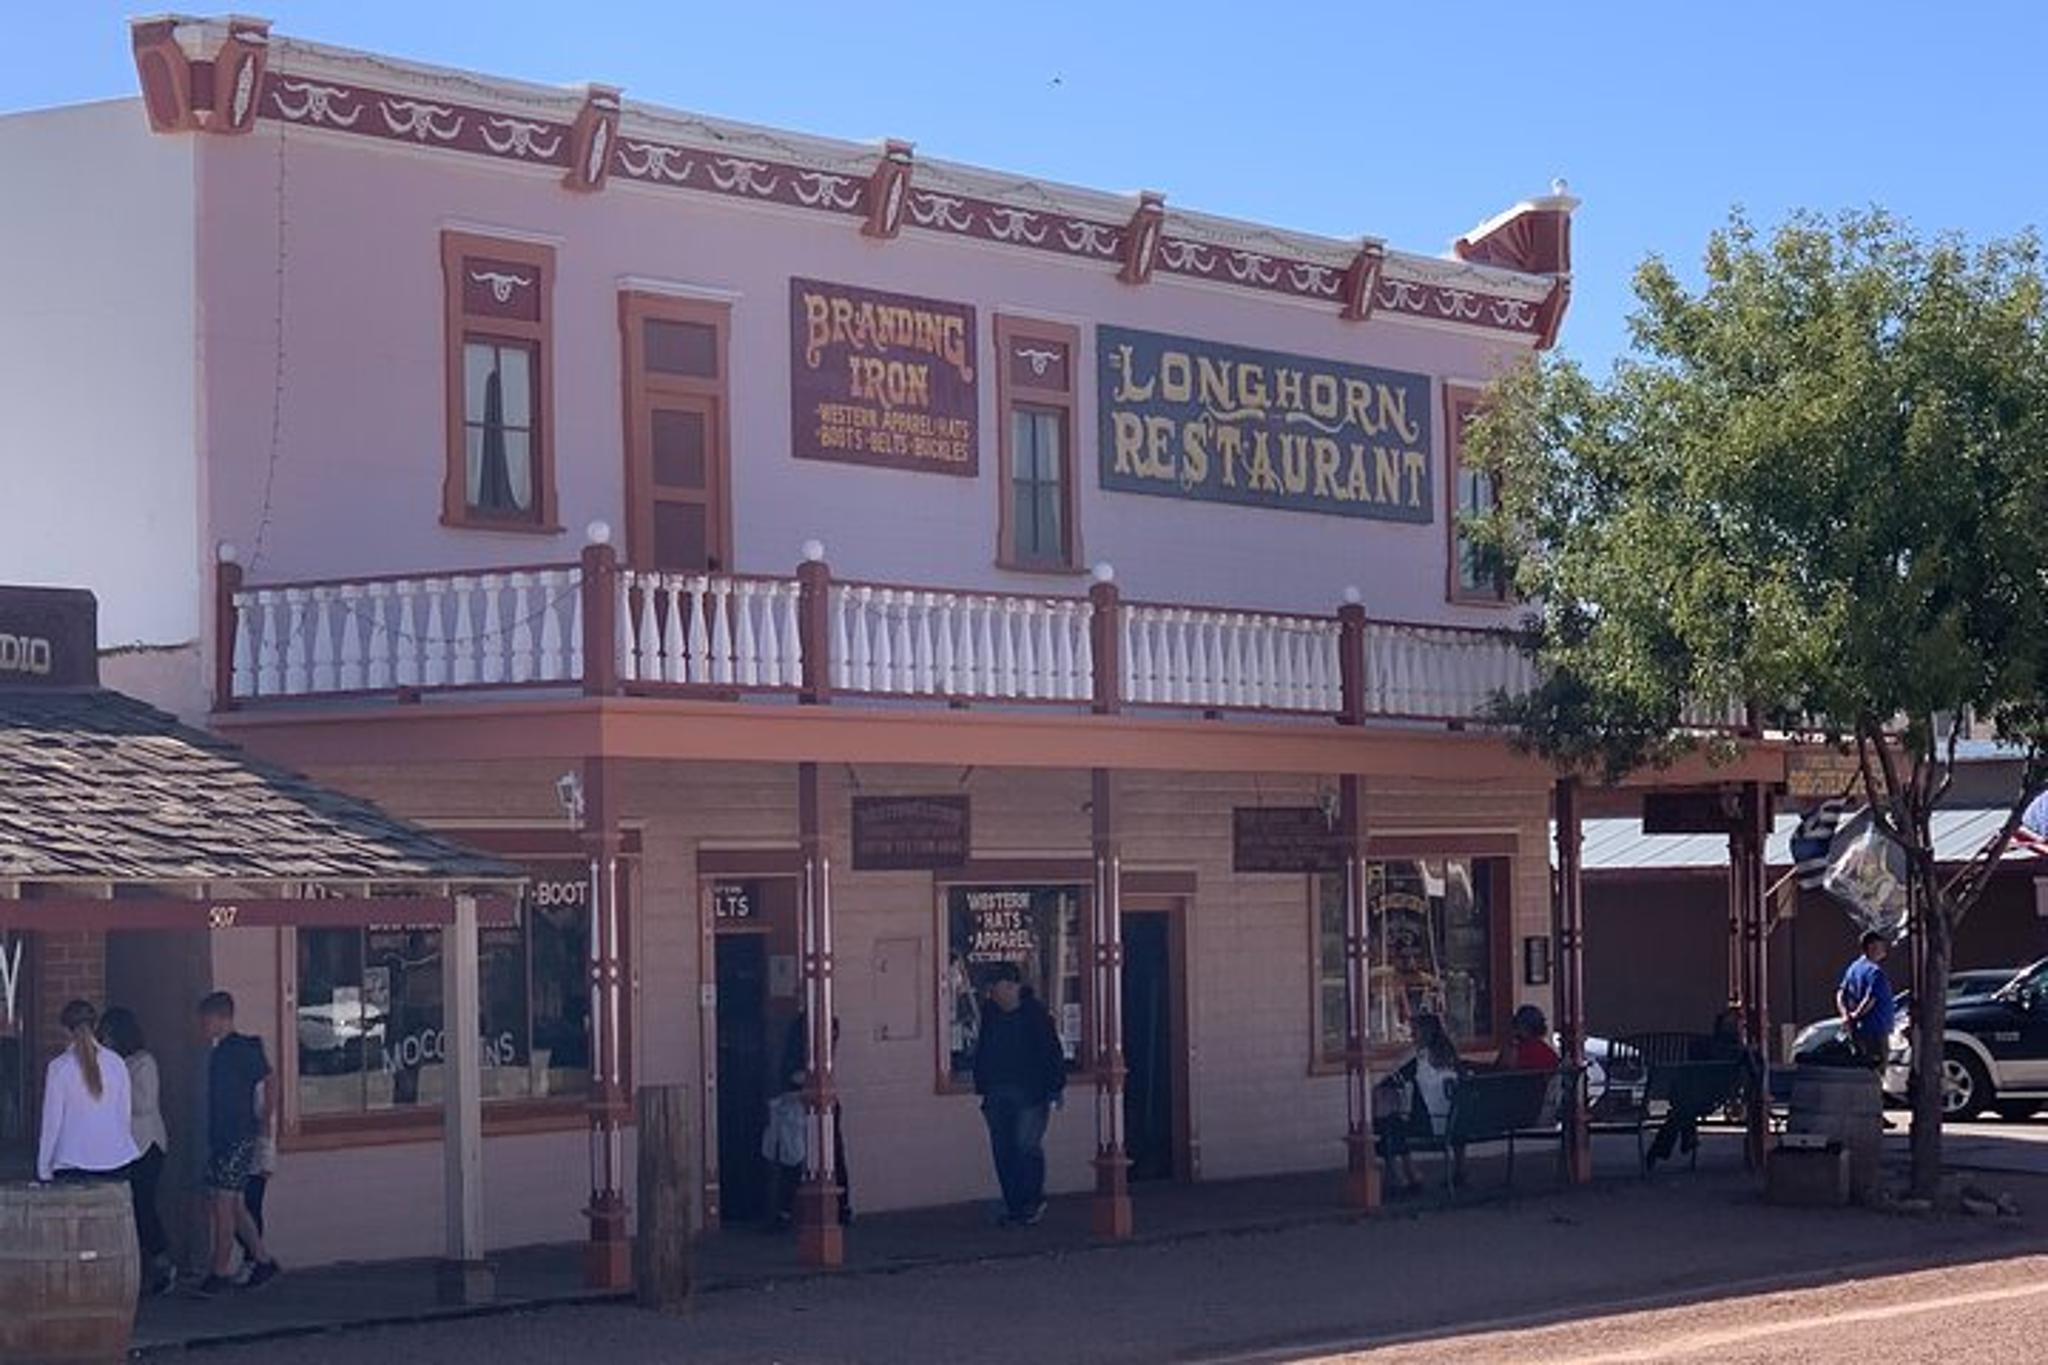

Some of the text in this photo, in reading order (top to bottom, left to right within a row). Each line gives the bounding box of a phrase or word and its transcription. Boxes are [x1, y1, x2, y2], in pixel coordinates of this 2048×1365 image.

[804, 293, 973, 382] BRANDING
[849, 356, 929, 410] IRON
[1109, 344, 1419, 444] LONGHORN
[1112, 411, 1425, 507] RESTAURANT
[0, 634, 50, 674] DIO
